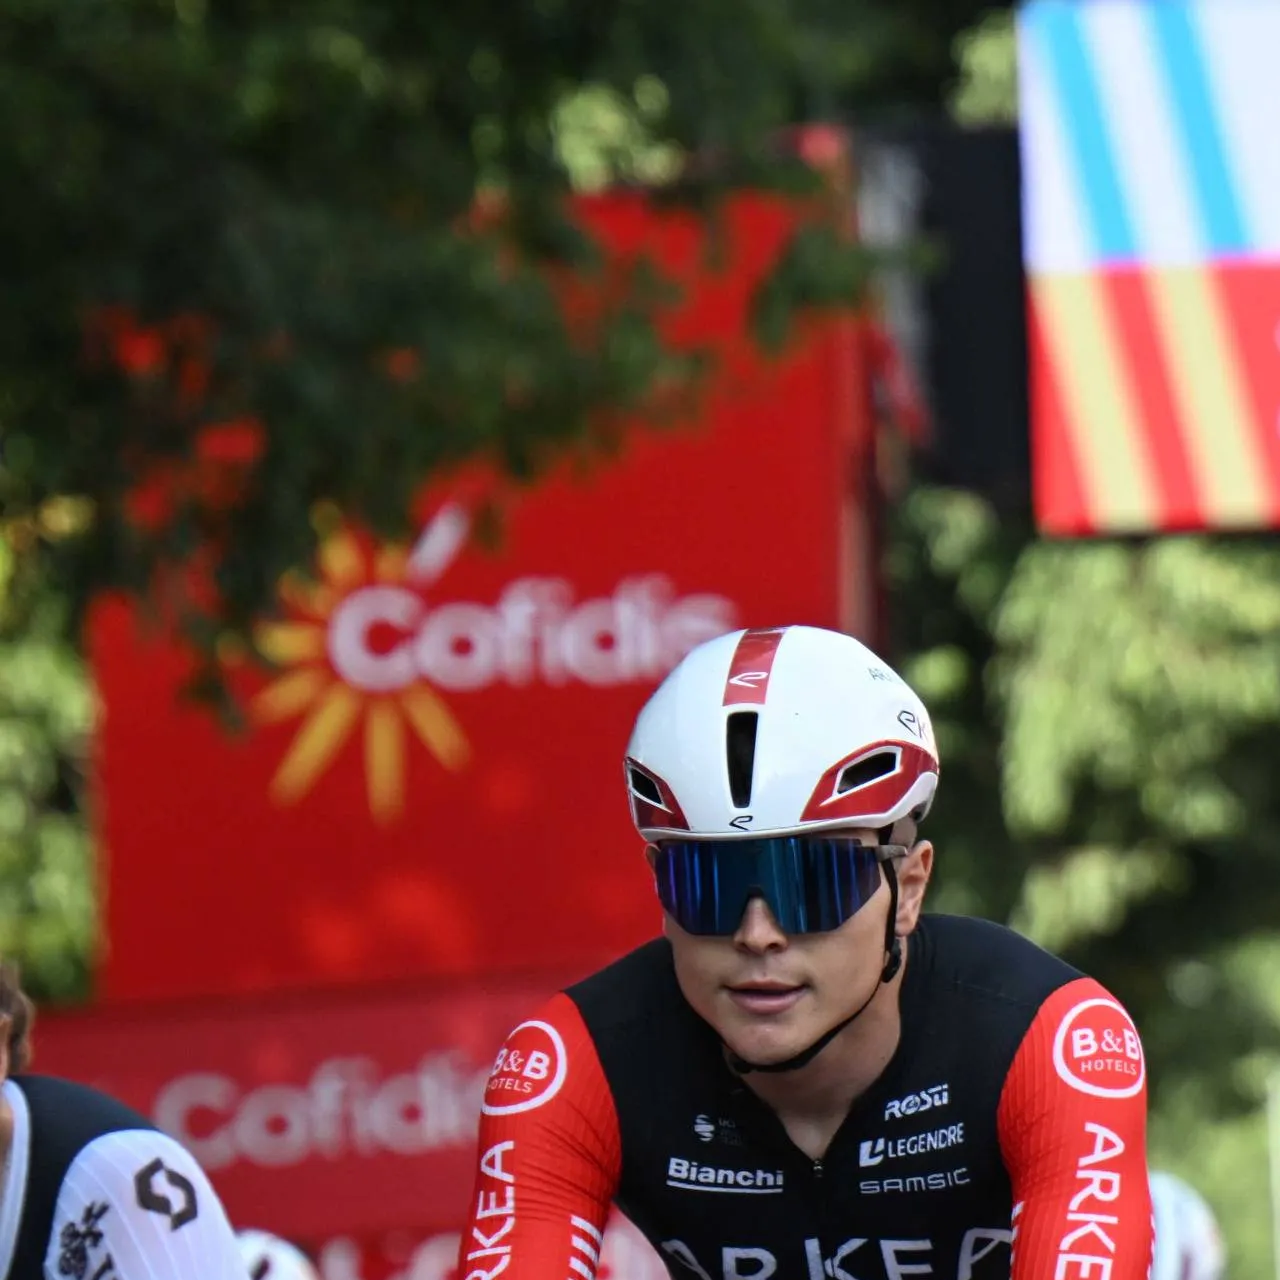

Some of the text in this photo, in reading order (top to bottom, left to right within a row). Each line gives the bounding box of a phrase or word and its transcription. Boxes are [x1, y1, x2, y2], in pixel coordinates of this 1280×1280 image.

[1072, 1028, 1140, 1059] B&B
[1081, 1058, 1137, 1076] HOTELS
[487, 1077, 533, 1094] OTELS
[153, 1052, 487, 1169] Cofidi
[887, 1122, 964, 1158] LEGENDRE
[668, 1157, 784, 1187] Bianchi
